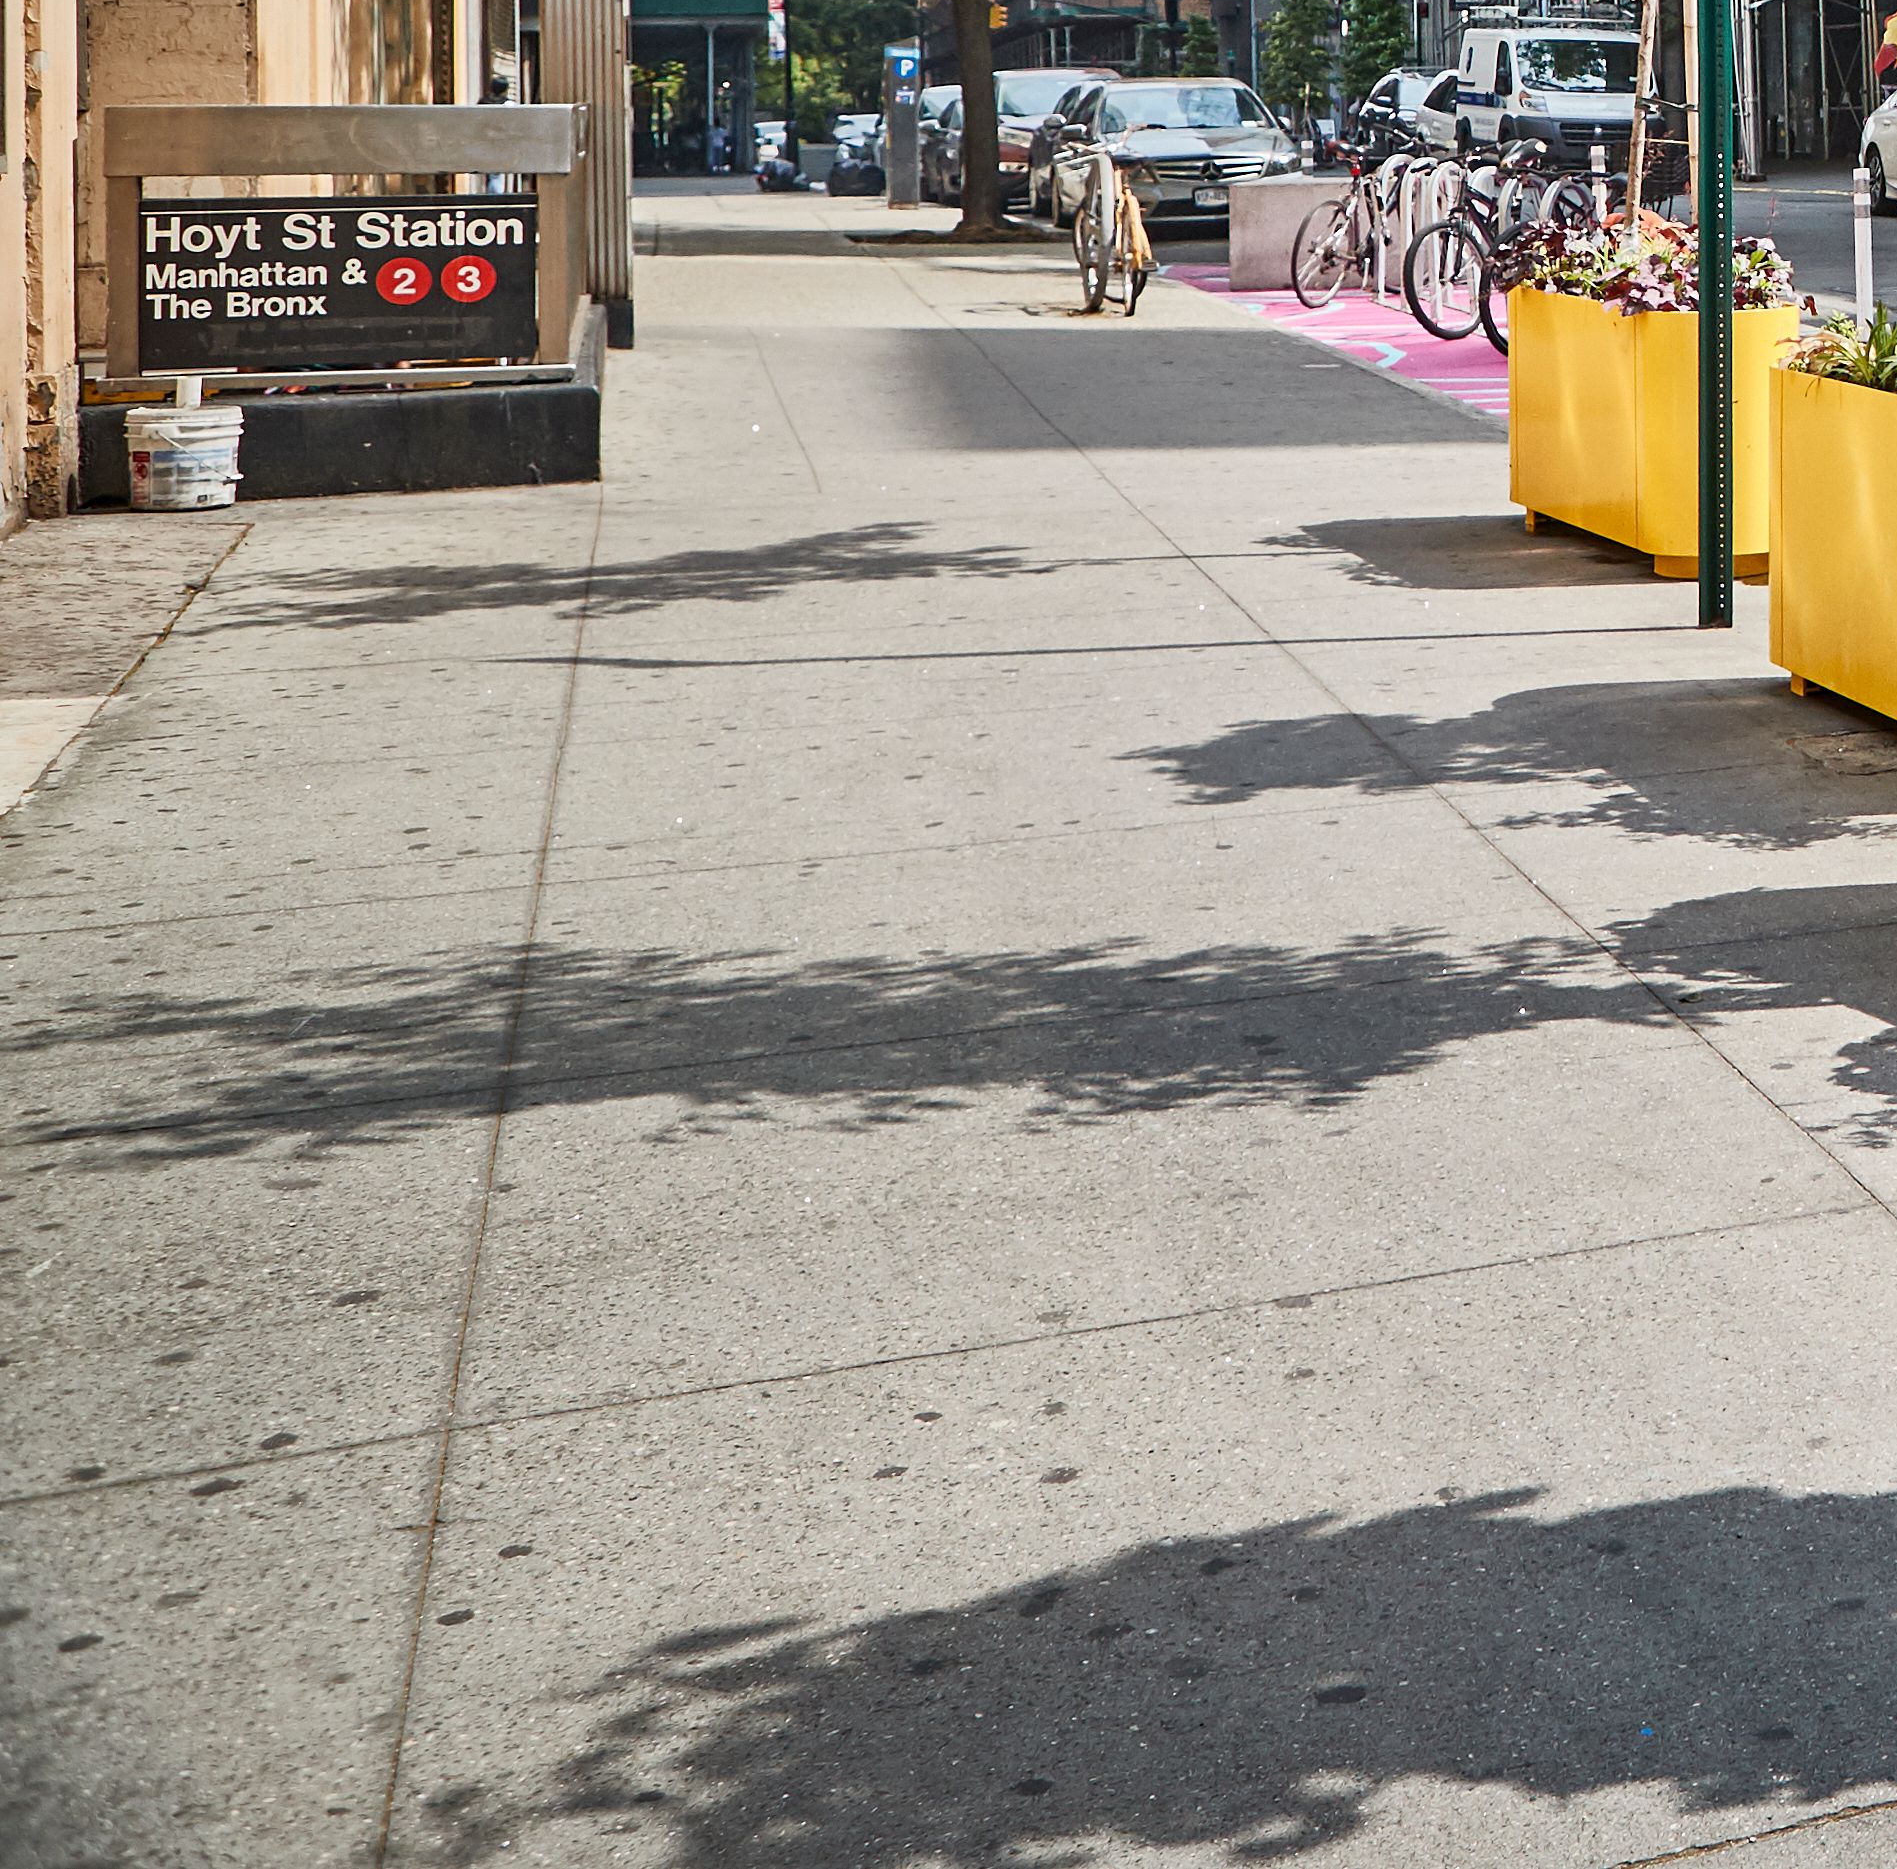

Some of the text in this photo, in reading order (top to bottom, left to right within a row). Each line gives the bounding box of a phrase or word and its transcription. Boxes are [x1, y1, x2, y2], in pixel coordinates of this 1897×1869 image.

[900, 59, 914, 76] P
[146, 210, 524, 259] Hoyt St Station
[145, 257, 368, 291] Manhattan &
[392, 264, 482, 295] 2 3
[145, 291, 328, 320] The Bronx
